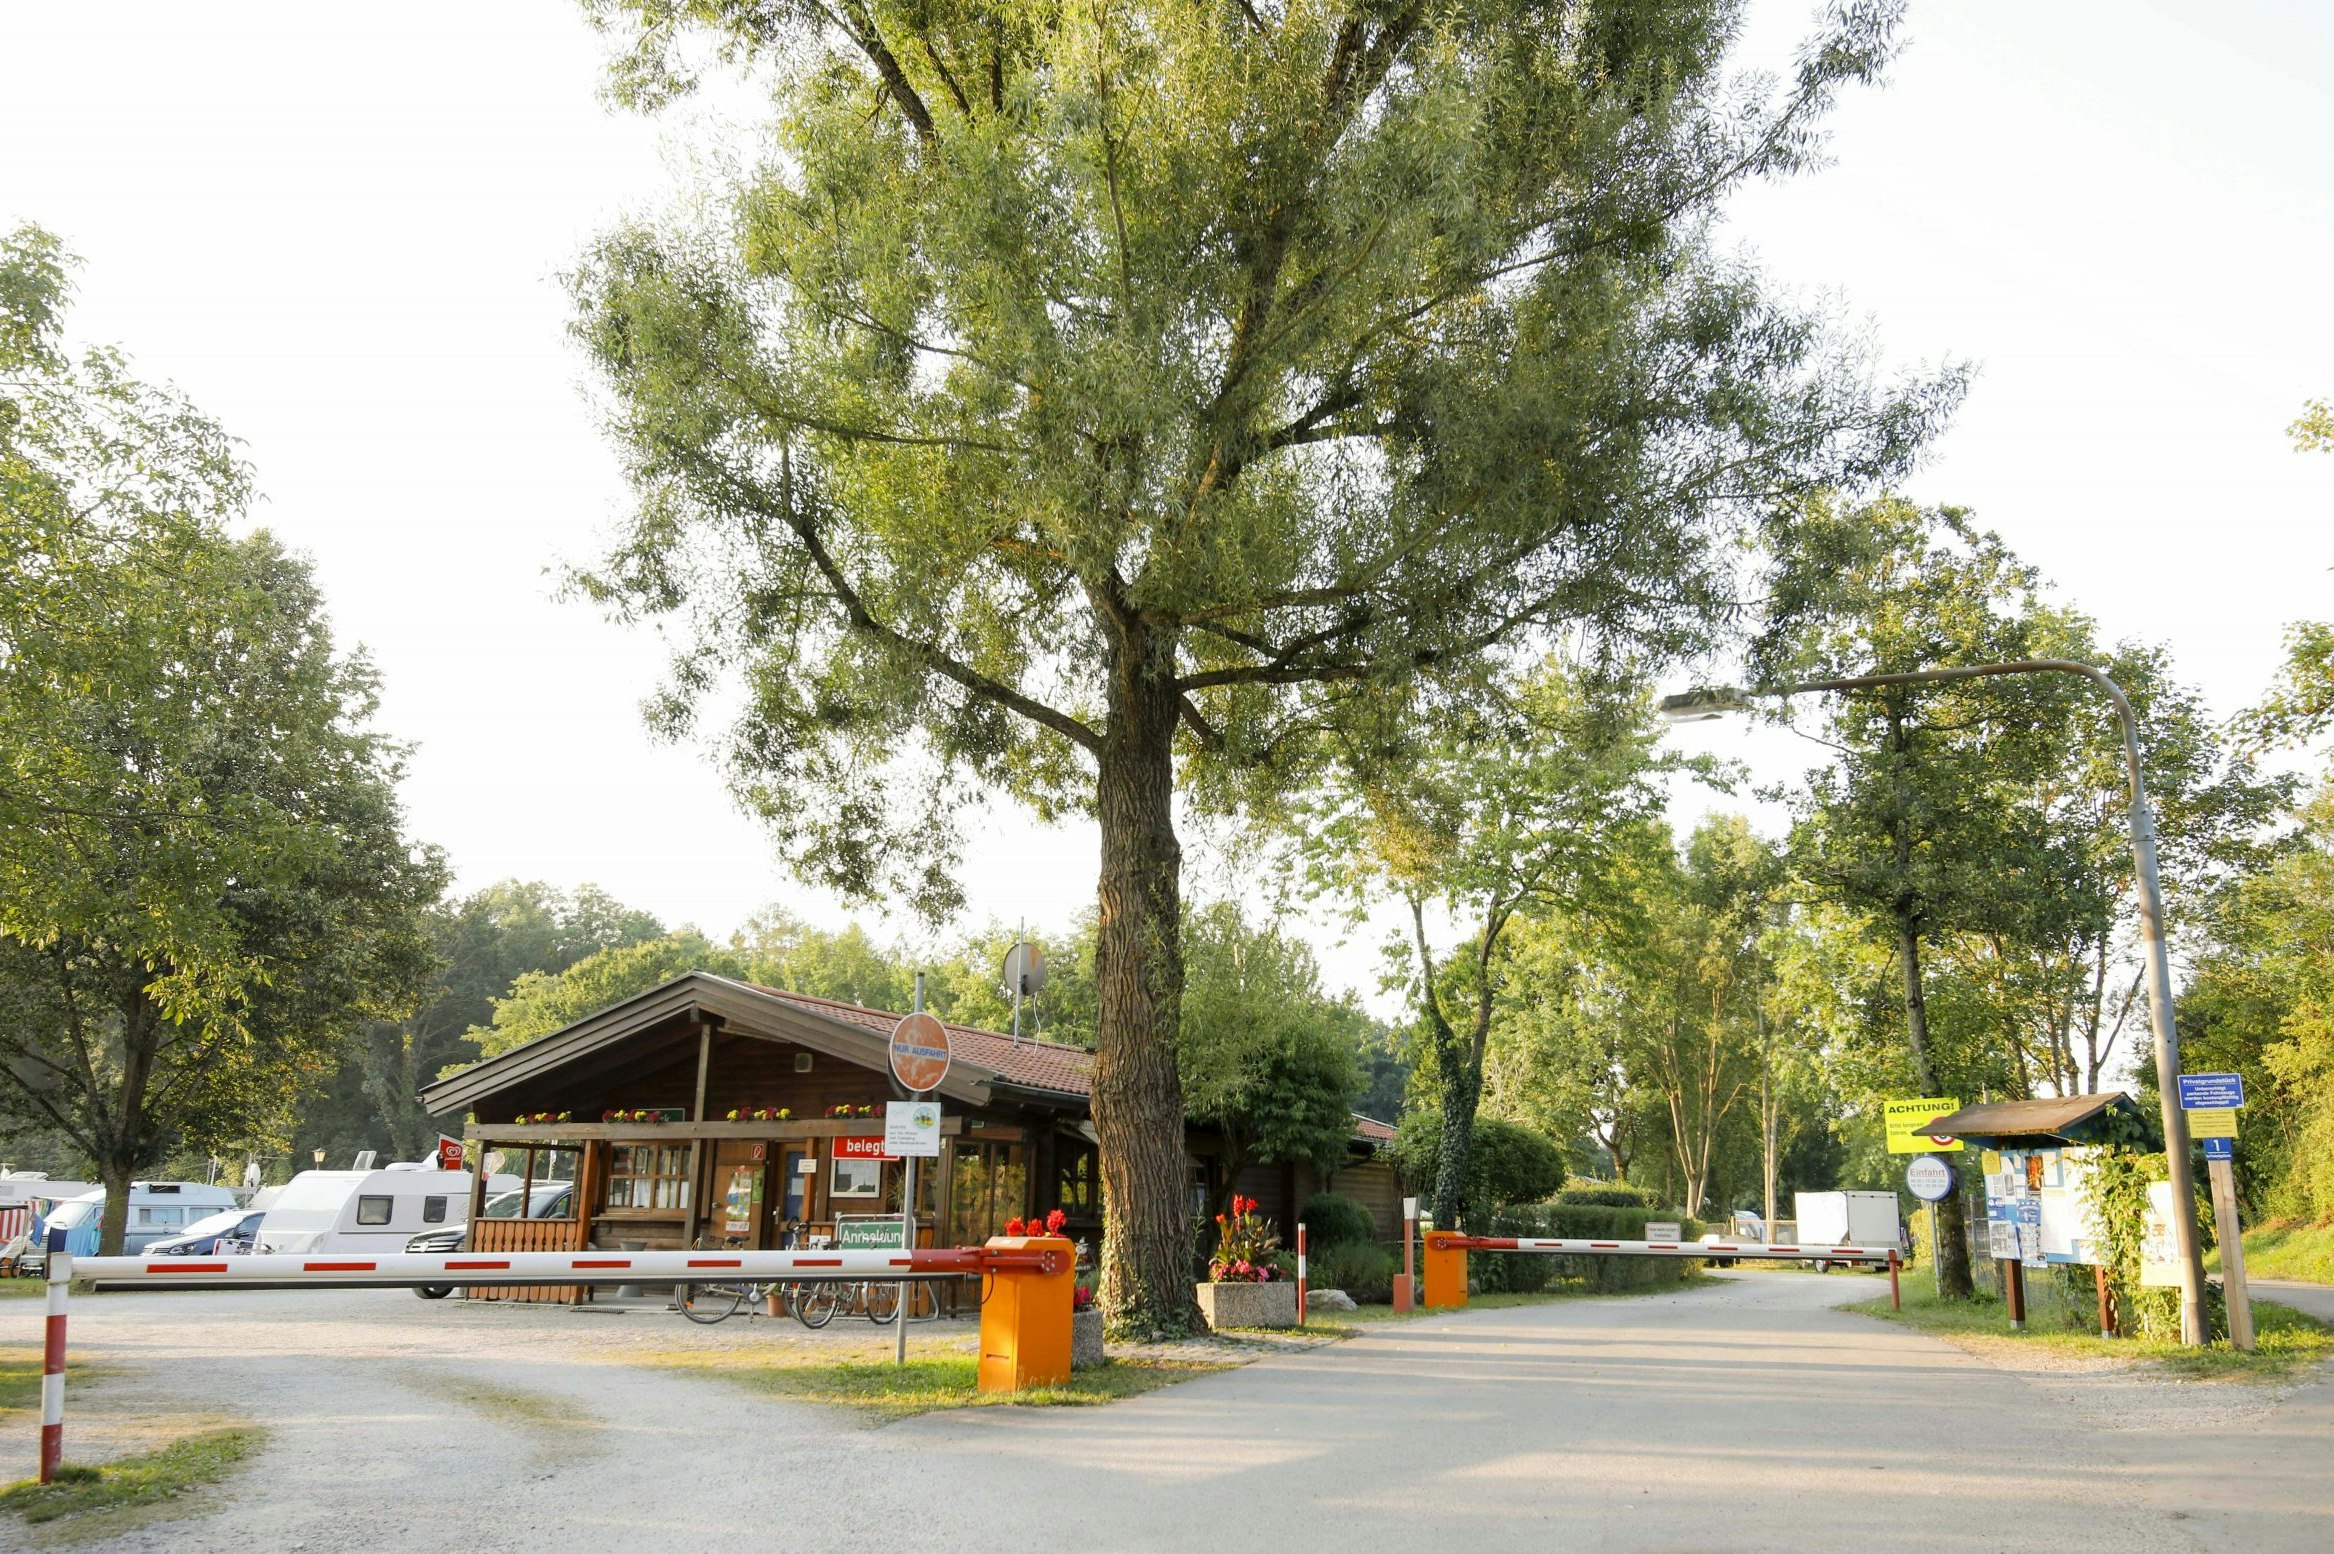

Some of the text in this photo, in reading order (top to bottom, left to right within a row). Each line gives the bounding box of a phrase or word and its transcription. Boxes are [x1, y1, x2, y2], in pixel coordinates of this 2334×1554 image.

[894, 1043, 946, 1059] NUR AUSFAHRT
[1888, 1102, 1955, 1114] ACHTUNG!
[847, 1138, 885, 1155] belegt
[2213, 1139, 2220, 1152] 1
[1910, 1167, 1946, 1176] Einfahrt
[841, 1228, 904, 1244] Anmeldun
